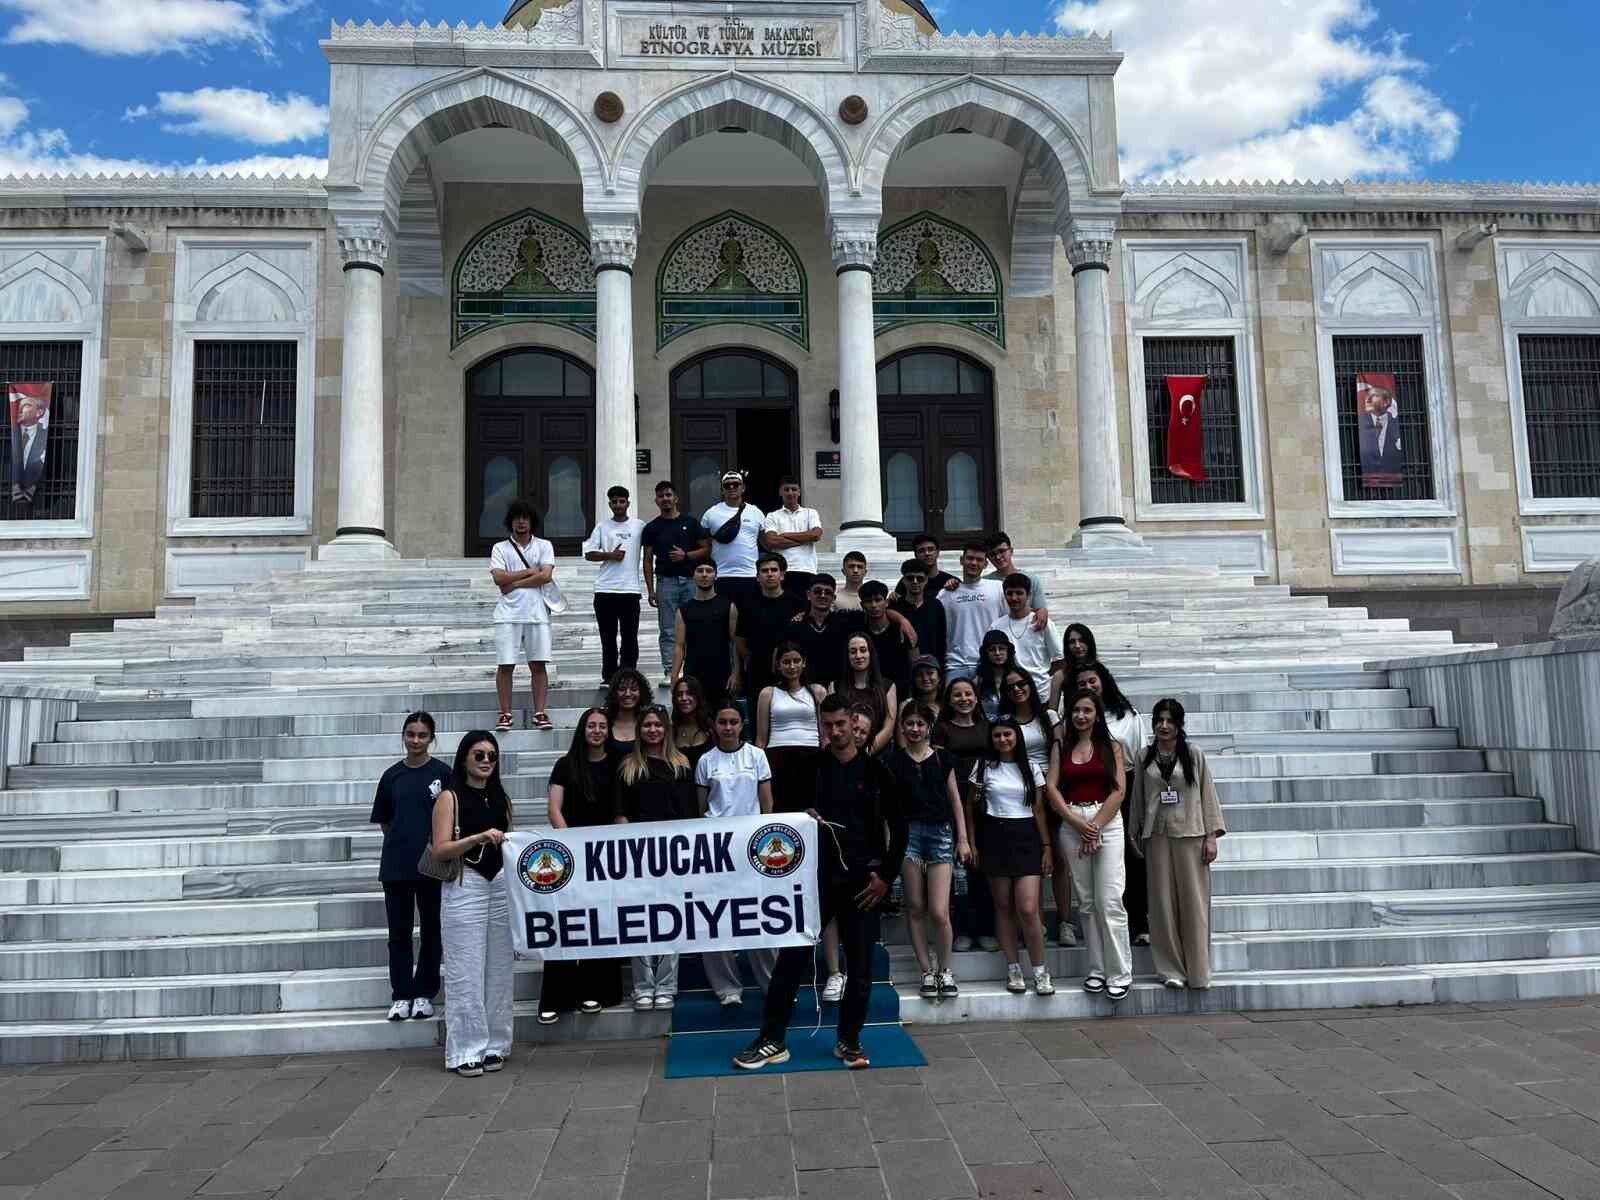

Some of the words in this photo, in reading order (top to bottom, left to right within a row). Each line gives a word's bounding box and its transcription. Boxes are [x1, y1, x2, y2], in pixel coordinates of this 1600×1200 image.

[640, 41, 754, 56] ETNOGRAFYA
[761, 41, 822, 57] MÜZESİ
[649, 24, 687, 40] KÜLTÜR
[697, 26, 710, 40] VE
[764, 26, 815, 41] BAKANLIĞI
[584, 832, 736, 882] KUYUCAK
[524, 884, 805, 949] BELEDİYESİ
